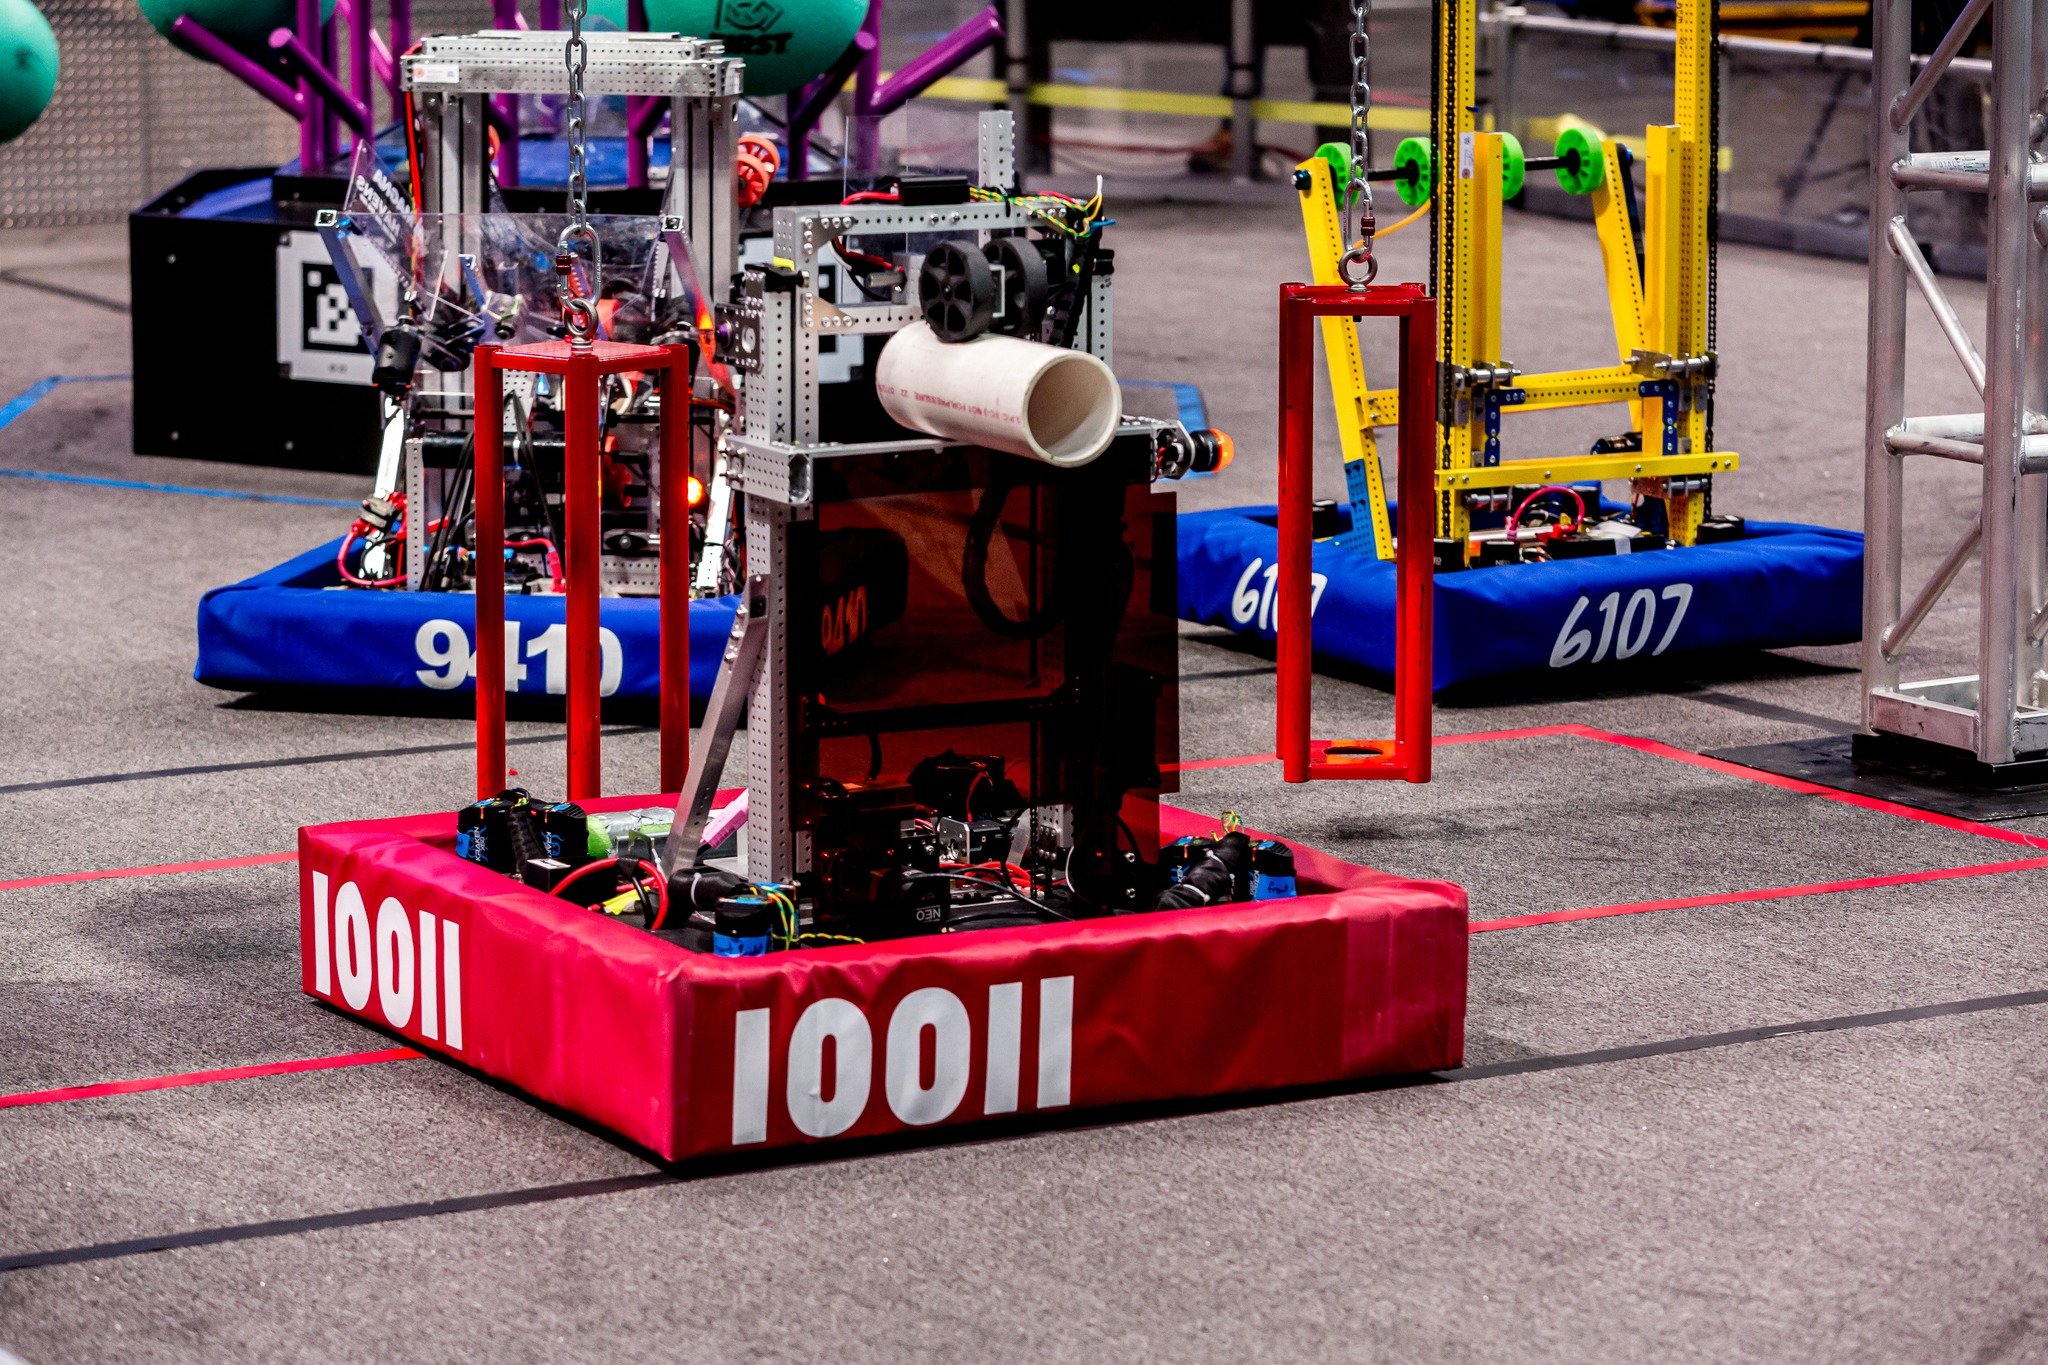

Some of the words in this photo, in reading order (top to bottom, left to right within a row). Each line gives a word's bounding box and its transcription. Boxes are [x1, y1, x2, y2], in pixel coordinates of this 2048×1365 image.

[1232, 557, 1328, 633] 617
[1549, 583, 1693, 668] 6107
[473, 826, 481, 862] KRAKEN
[916, 907, 941, 921] NEO
[313, 870, 463, 1051] 10011
[732, 975, 1074, 1145] 10011
